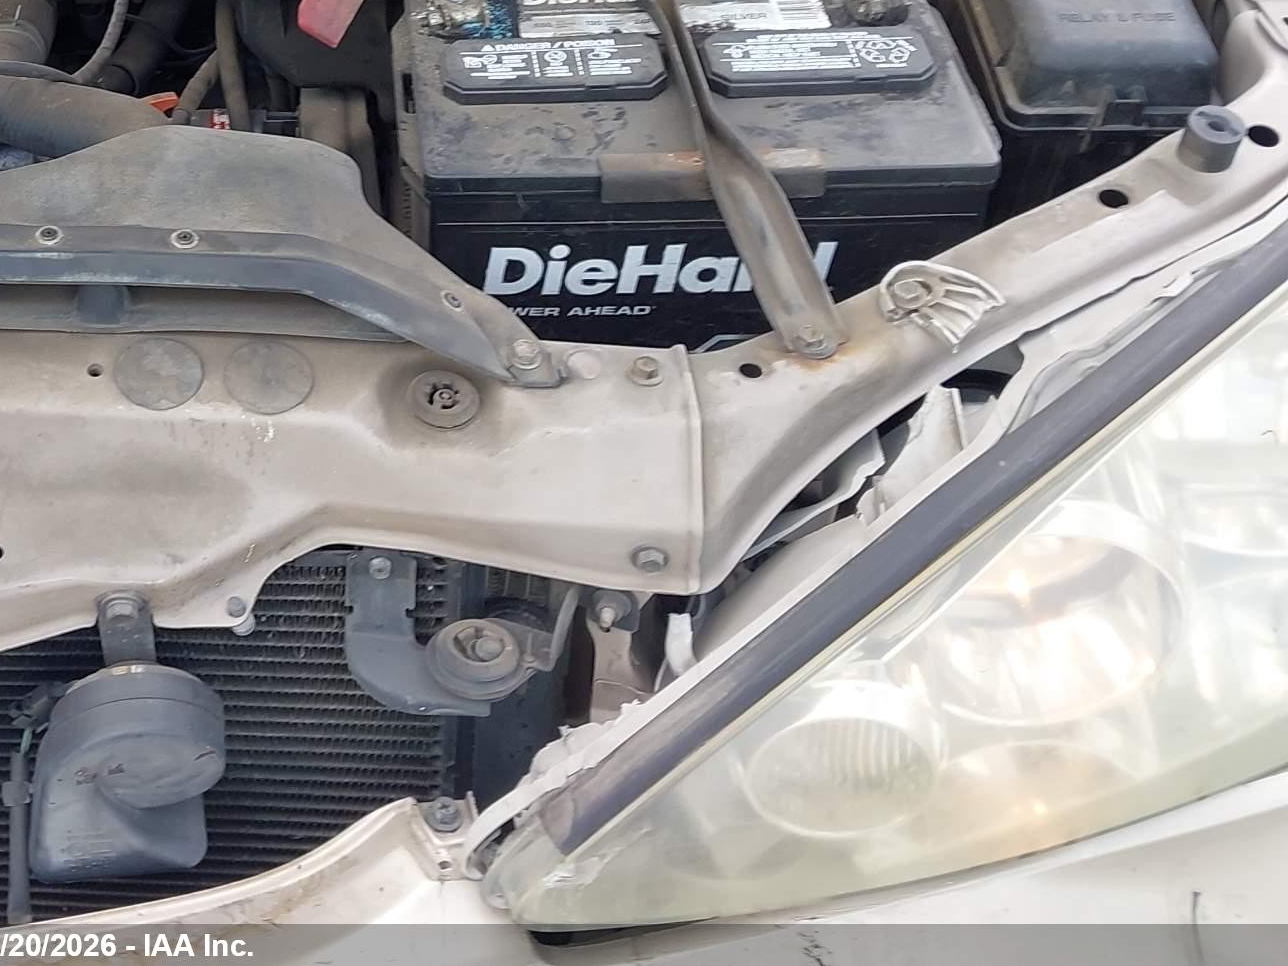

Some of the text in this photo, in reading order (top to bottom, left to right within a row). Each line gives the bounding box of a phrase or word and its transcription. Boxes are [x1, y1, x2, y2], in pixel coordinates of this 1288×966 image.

[496, 42, 551, 52] DANGER
[564, 39, 615, 48] POISON
[507, 305, 654, 317] WER AHEAD
